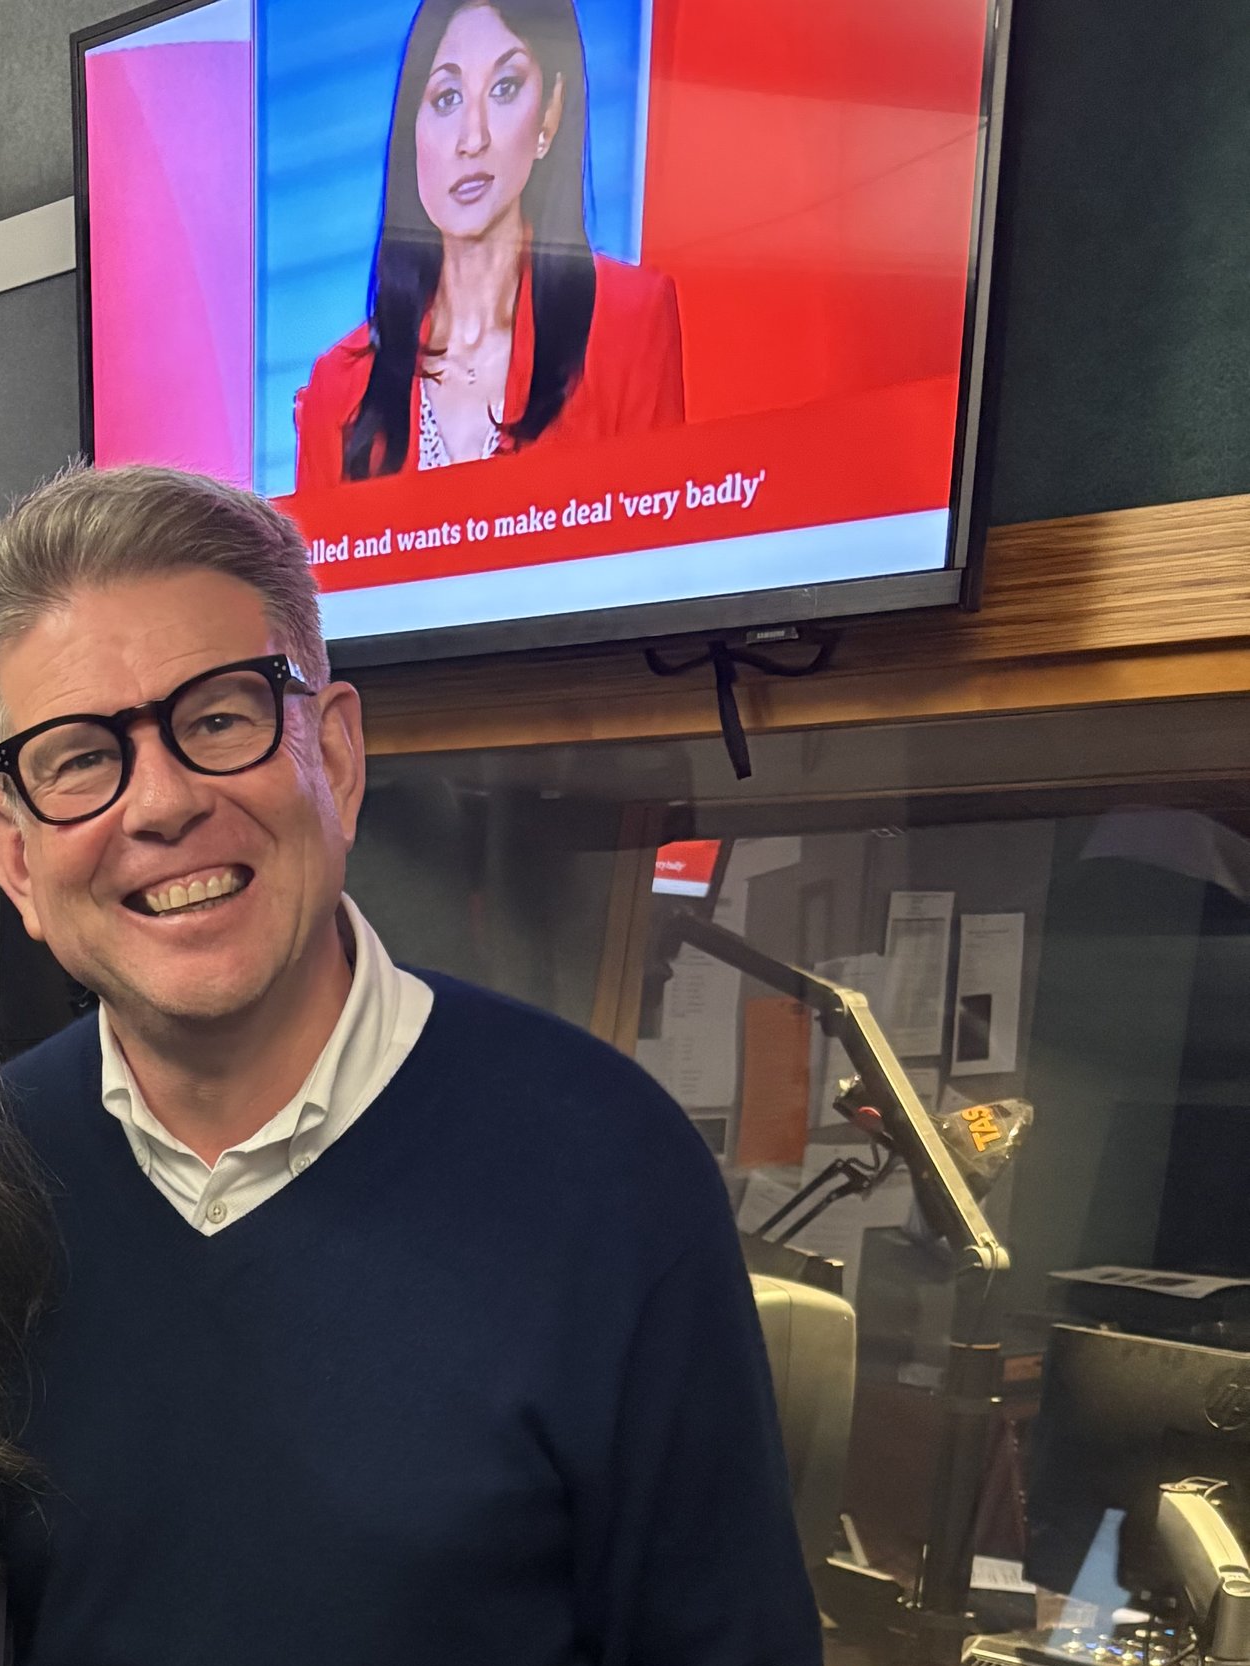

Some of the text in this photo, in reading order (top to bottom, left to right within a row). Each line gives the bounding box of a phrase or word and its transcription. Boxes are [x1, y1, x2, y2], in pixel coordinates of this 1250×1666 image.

[353, 528, 393, 559] and
[396, 518, 462, 552] wants
[466, 516, 490, 543] to
[493, 505, 557, 538] make
[561, 493, 613, 528] deal
[618, 489, 681, 520] 'very
[685, 470, 766, 510] badly'
